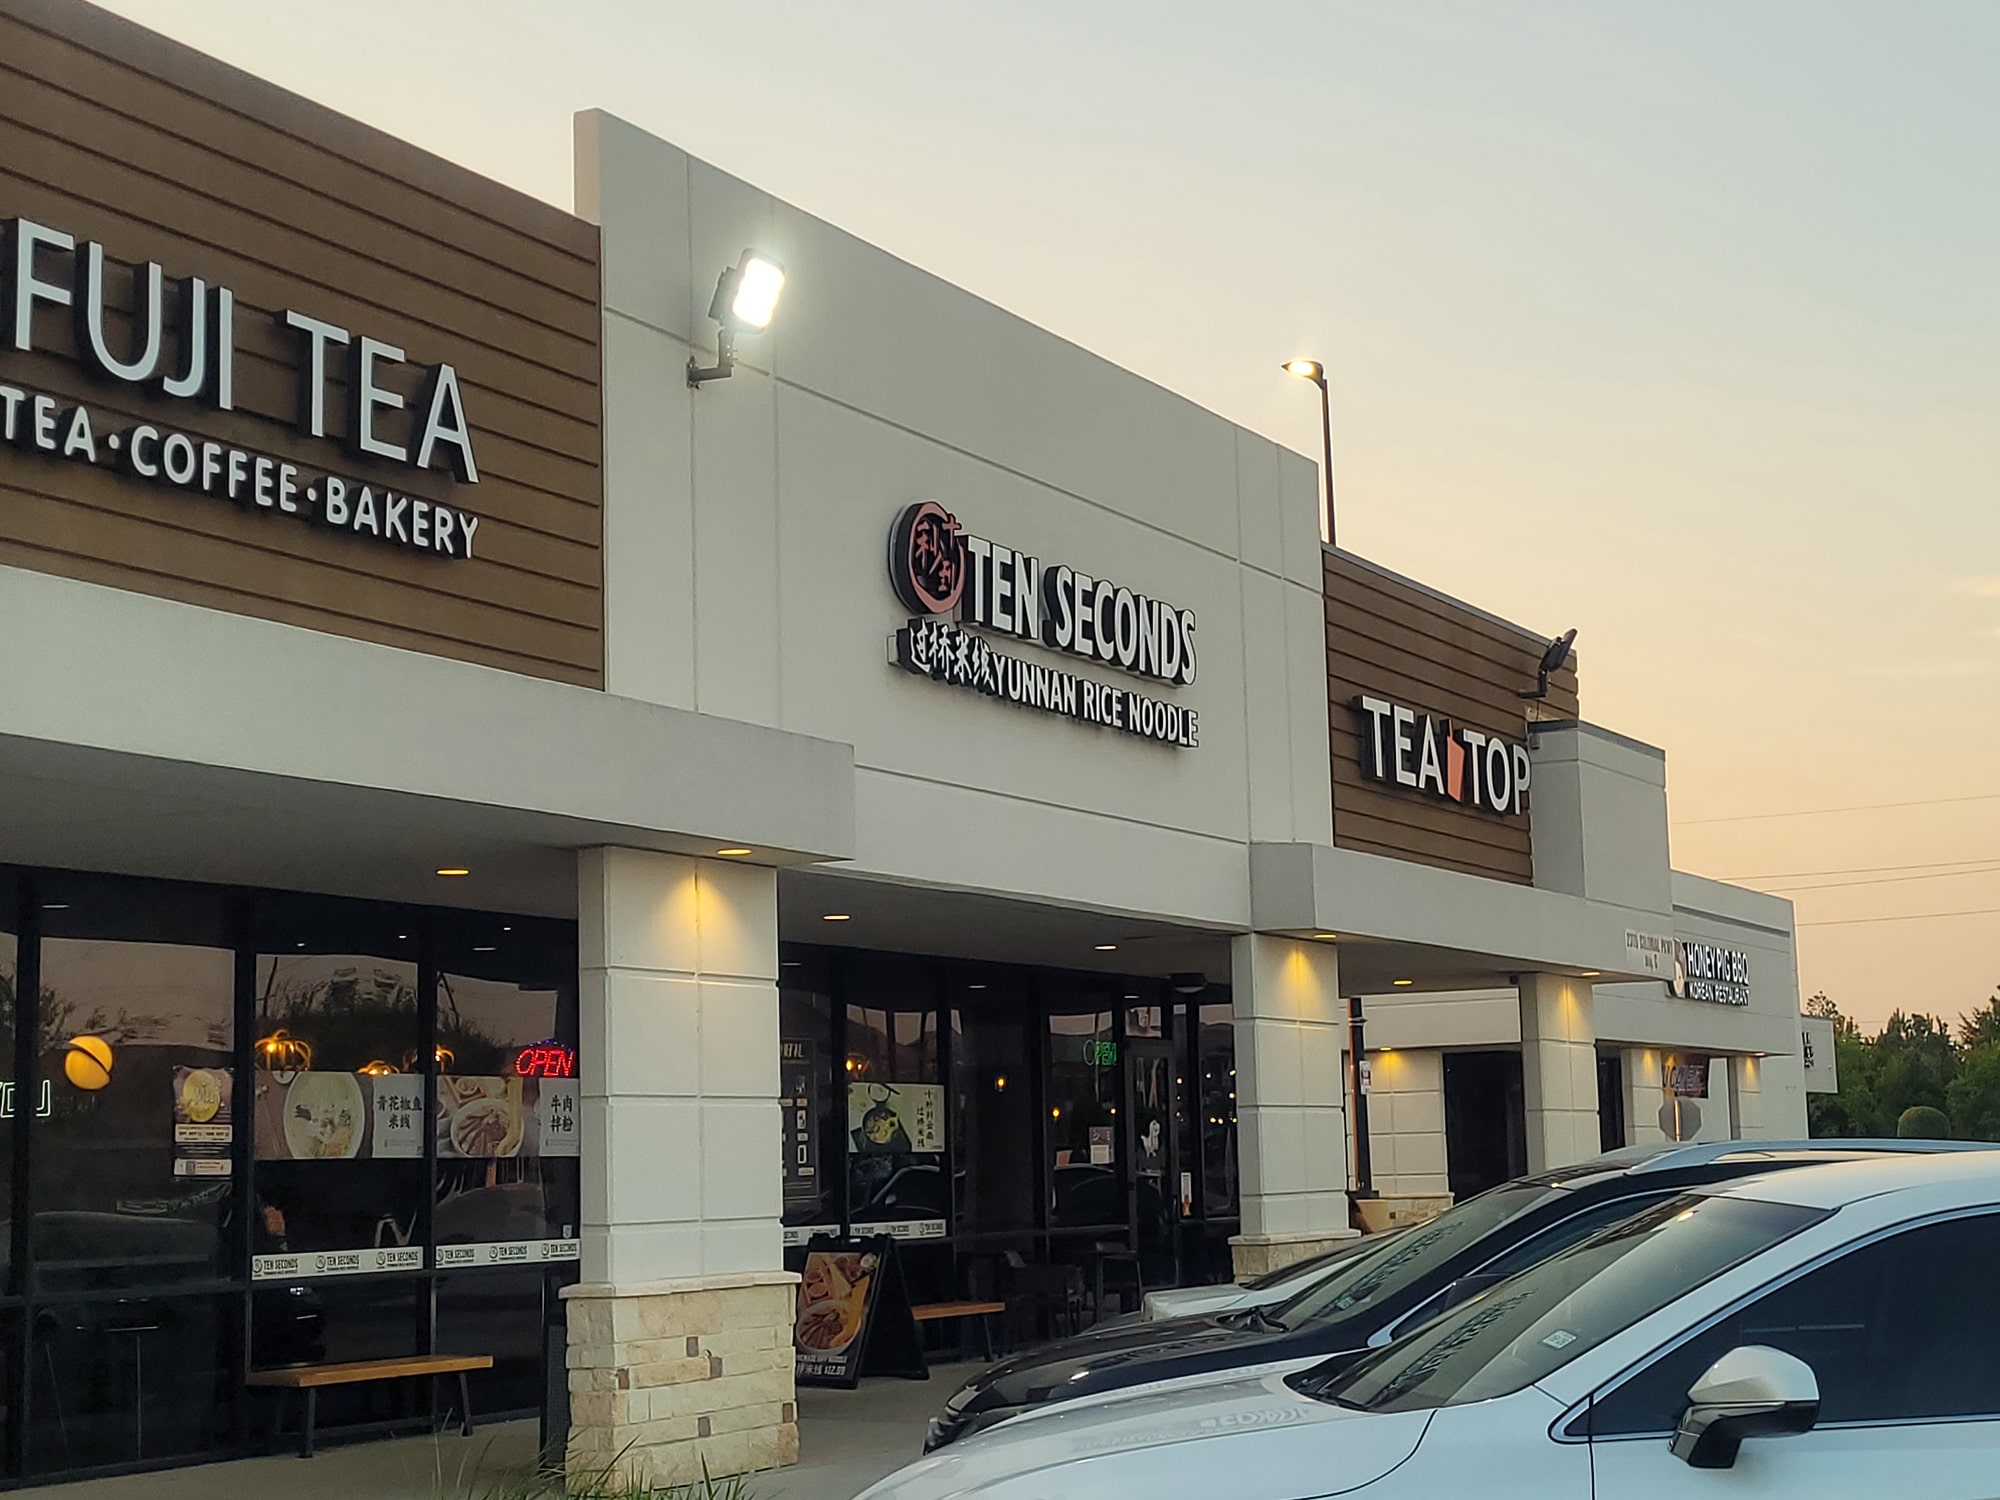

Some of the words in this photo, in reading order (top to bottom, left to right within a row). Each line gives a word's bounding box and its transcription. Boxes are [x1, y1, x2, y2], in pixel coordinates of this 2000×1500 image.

[15, 216, 234, 412] FUJI
[285, 308, 480, 485] TEA
[0, 385, 97, 464] TEA
[130, 424, 298, 514] COFFEE
[326, 476, 479, 559] BAKERY
[967, 534, 1040, 641] TEN
[1054, 563, 1198, 687] SECONDS
[992, 652, 1077, 718] YUNNAN
[1083, 679, 1124, 729] RICE
[1127, 691, 1200, 748] NOODLE
[1361, 694, 1447, 797] TEA
[1462, 727, 1533, 816] TOP
[1687, 941, 1717, 980] HONEY
[1716, 945, 1731, 983] PIG
[1731, 950, 1751, 988] BBQ
[1689, 980, 1715, 1003] KOREAN
[1714, 985, 1751, 1007] RESTAURANT
[515, 1048, 575, 1077] OPEN
[551, 1094, 573, 1113] 牛肉
[263, 1260, 274, 1271] TEN
[275, 1258, 298, 1269] SECONDS
[386, 1253, 396, 1263] TEN
[397, 1251, 418, 1262] SECONDS
